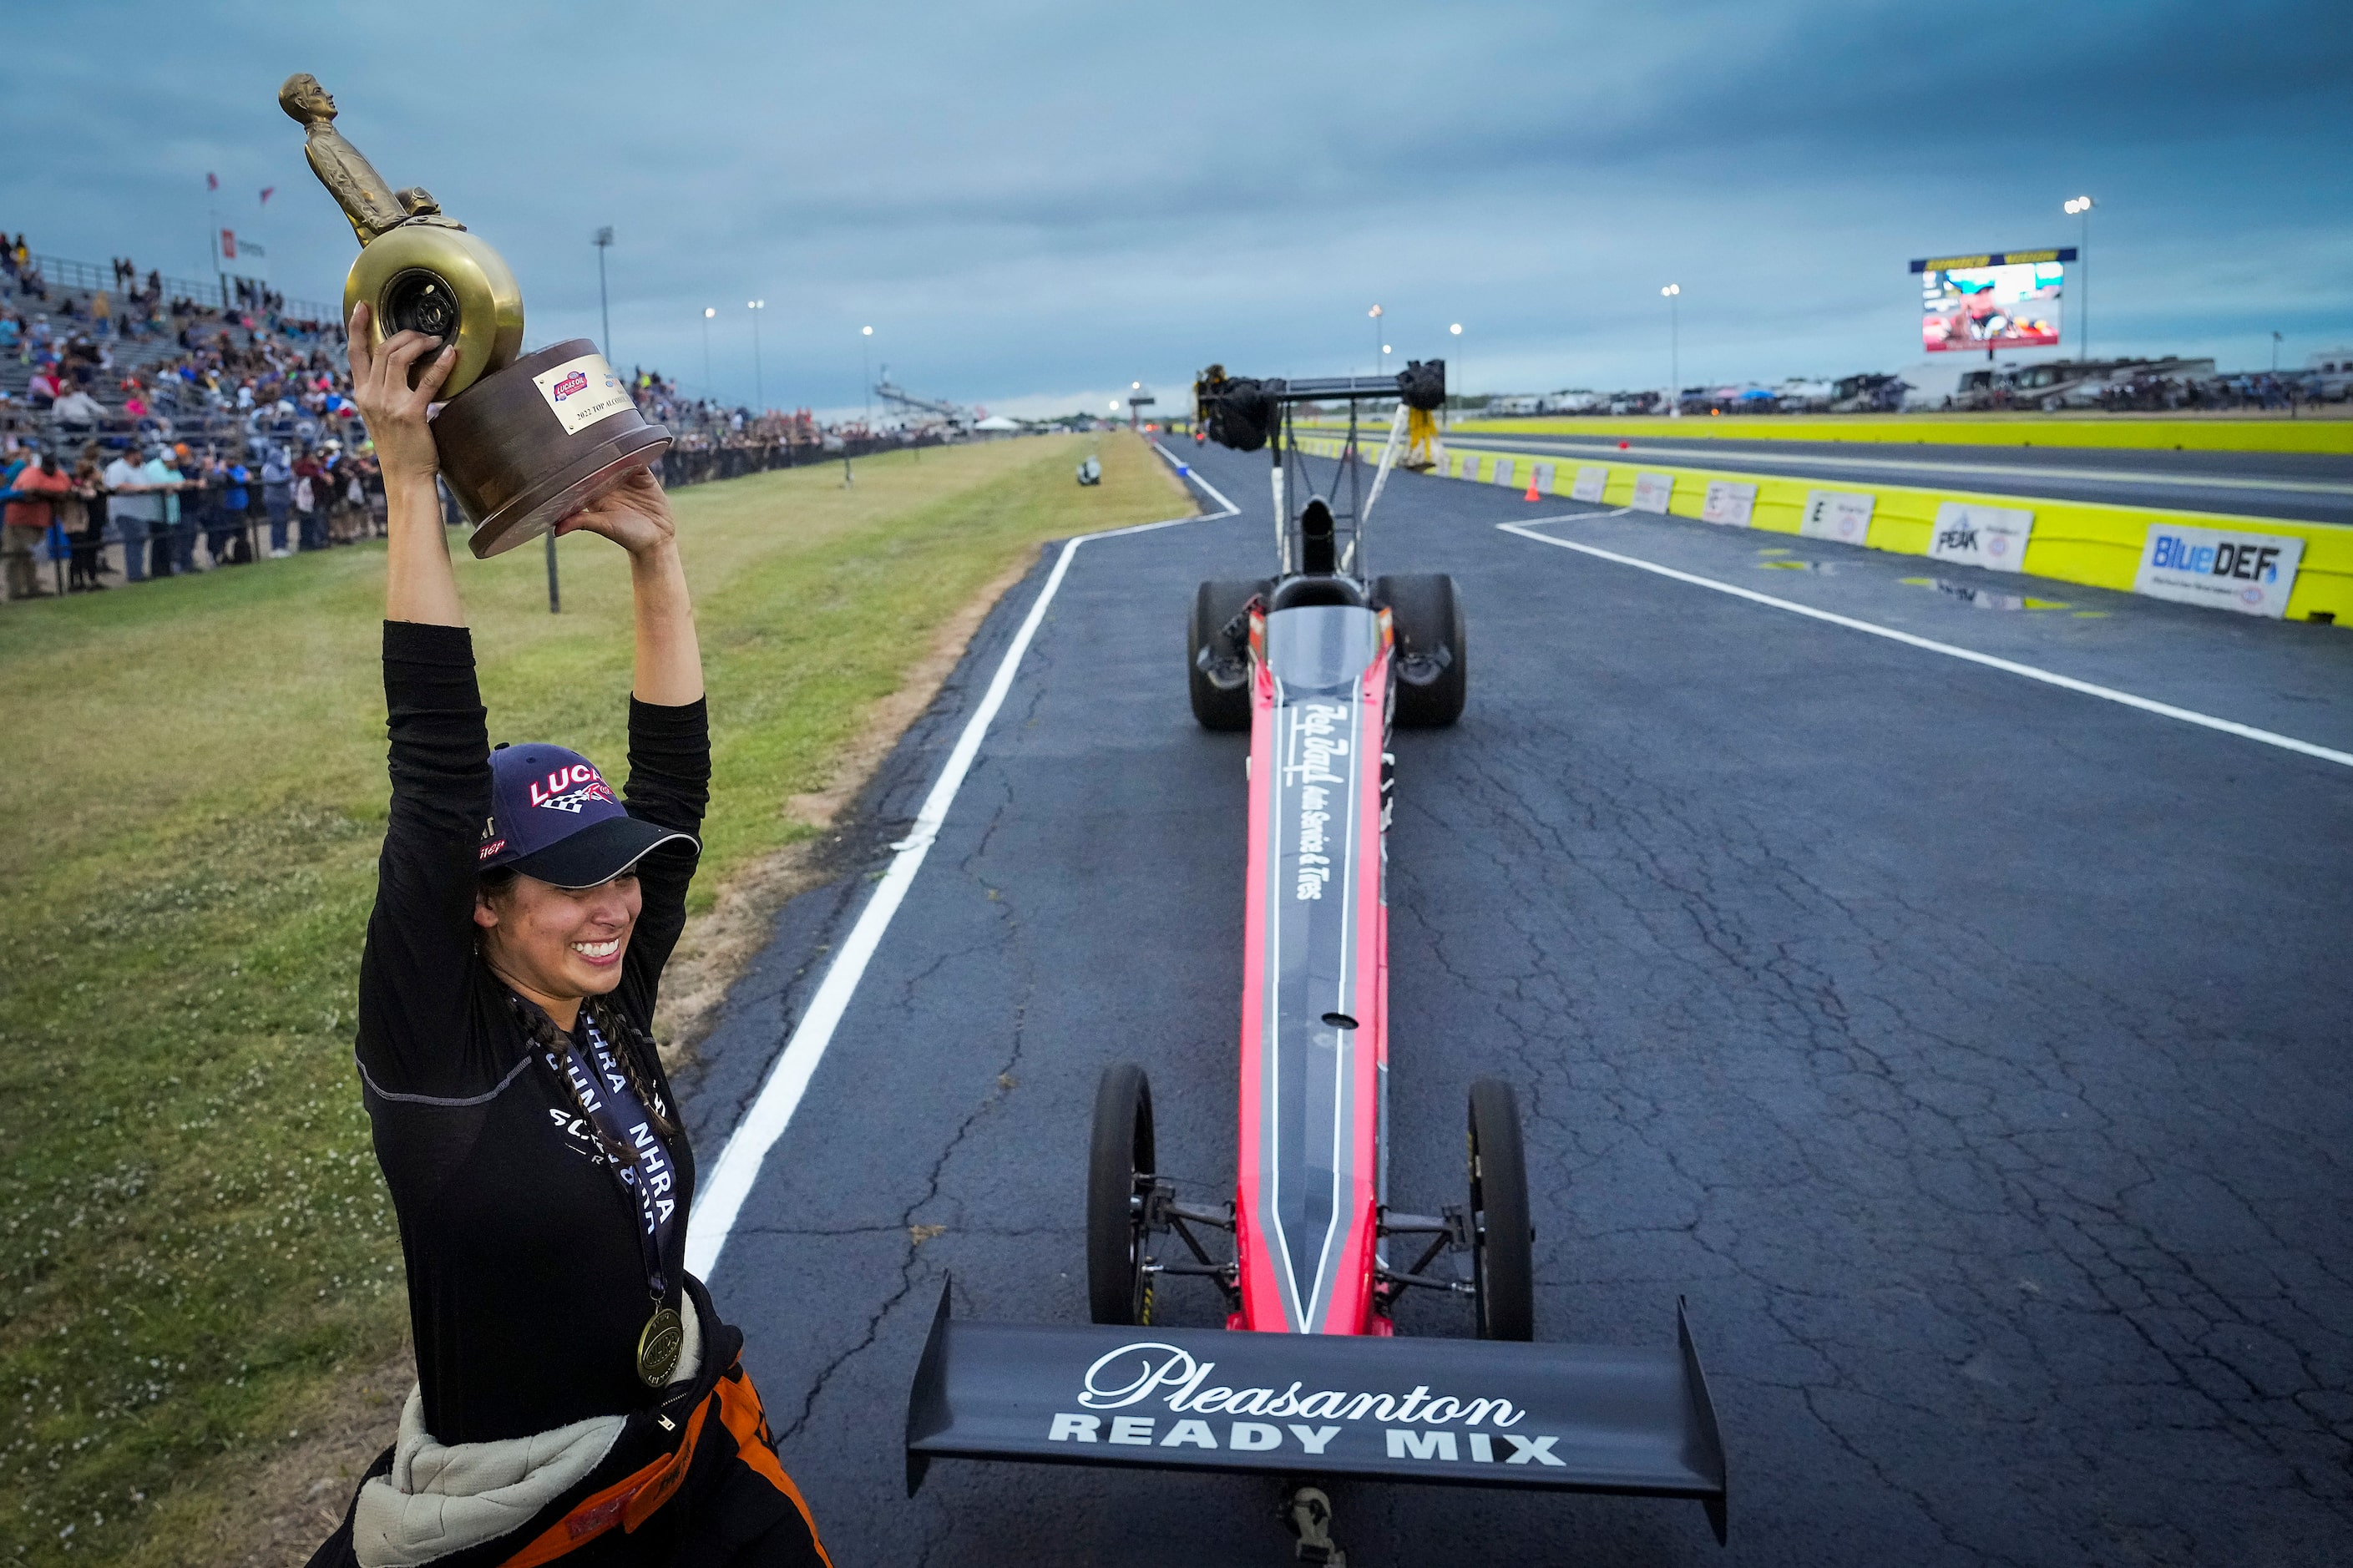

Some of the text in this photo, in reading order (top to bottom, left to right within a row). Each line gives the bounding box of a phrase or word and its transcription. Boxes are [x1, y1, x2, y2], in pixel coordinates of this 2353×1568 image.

[557, 380, 575, 394] LUCAS
[575, 377, 584, 386] OIL
[577, 408, 592, 420] 2022
[592, 403, 605, 413] TOP
[1936, 528, 1979, 553] PEAK
[2152, 535, 2281, 581] BlueDEF
[1298, 811, 1331, 853] Service
[1298, 853, 1330, 865] &
[1296, 867, 1330, 901] Tires
[629, 1121, 676, 1225] NHRA
[1078, 1343, 1526, 1428] Pleasanton
[1048, 1413, 1566, 1467] READY MIX
